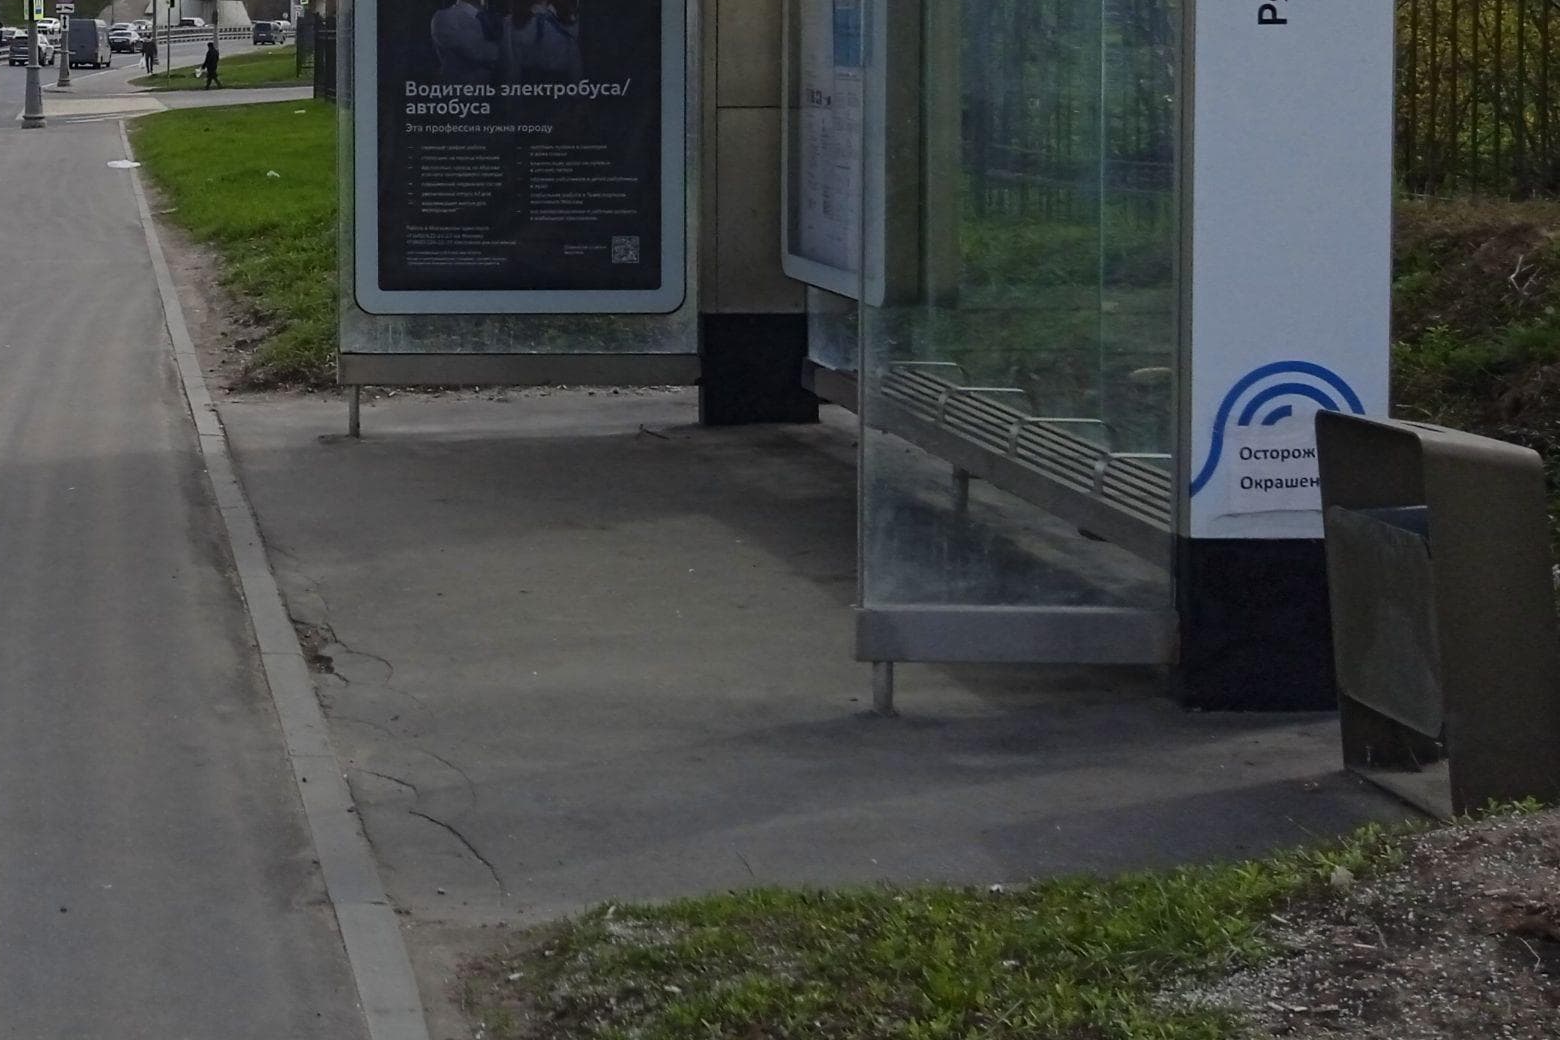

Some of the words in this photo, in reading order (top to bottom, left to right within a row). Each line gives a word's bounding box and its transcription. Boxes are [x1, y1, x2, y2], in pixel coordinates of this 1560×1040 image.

[405, 80, 496, 98] Водитель
[500, 77, 631, 99] электробуса/
[405, 98, 491, 118] автобуса
[405, 123, 423, 133] Эта
[425, 123, 481, 134] профессия
[483, 124, 515, 134] нужна
[517, 124, 553, 134] городу
[1239, 446, 1318, 462] Осторож
[1240, 475, 1320, 493] Окрашен
